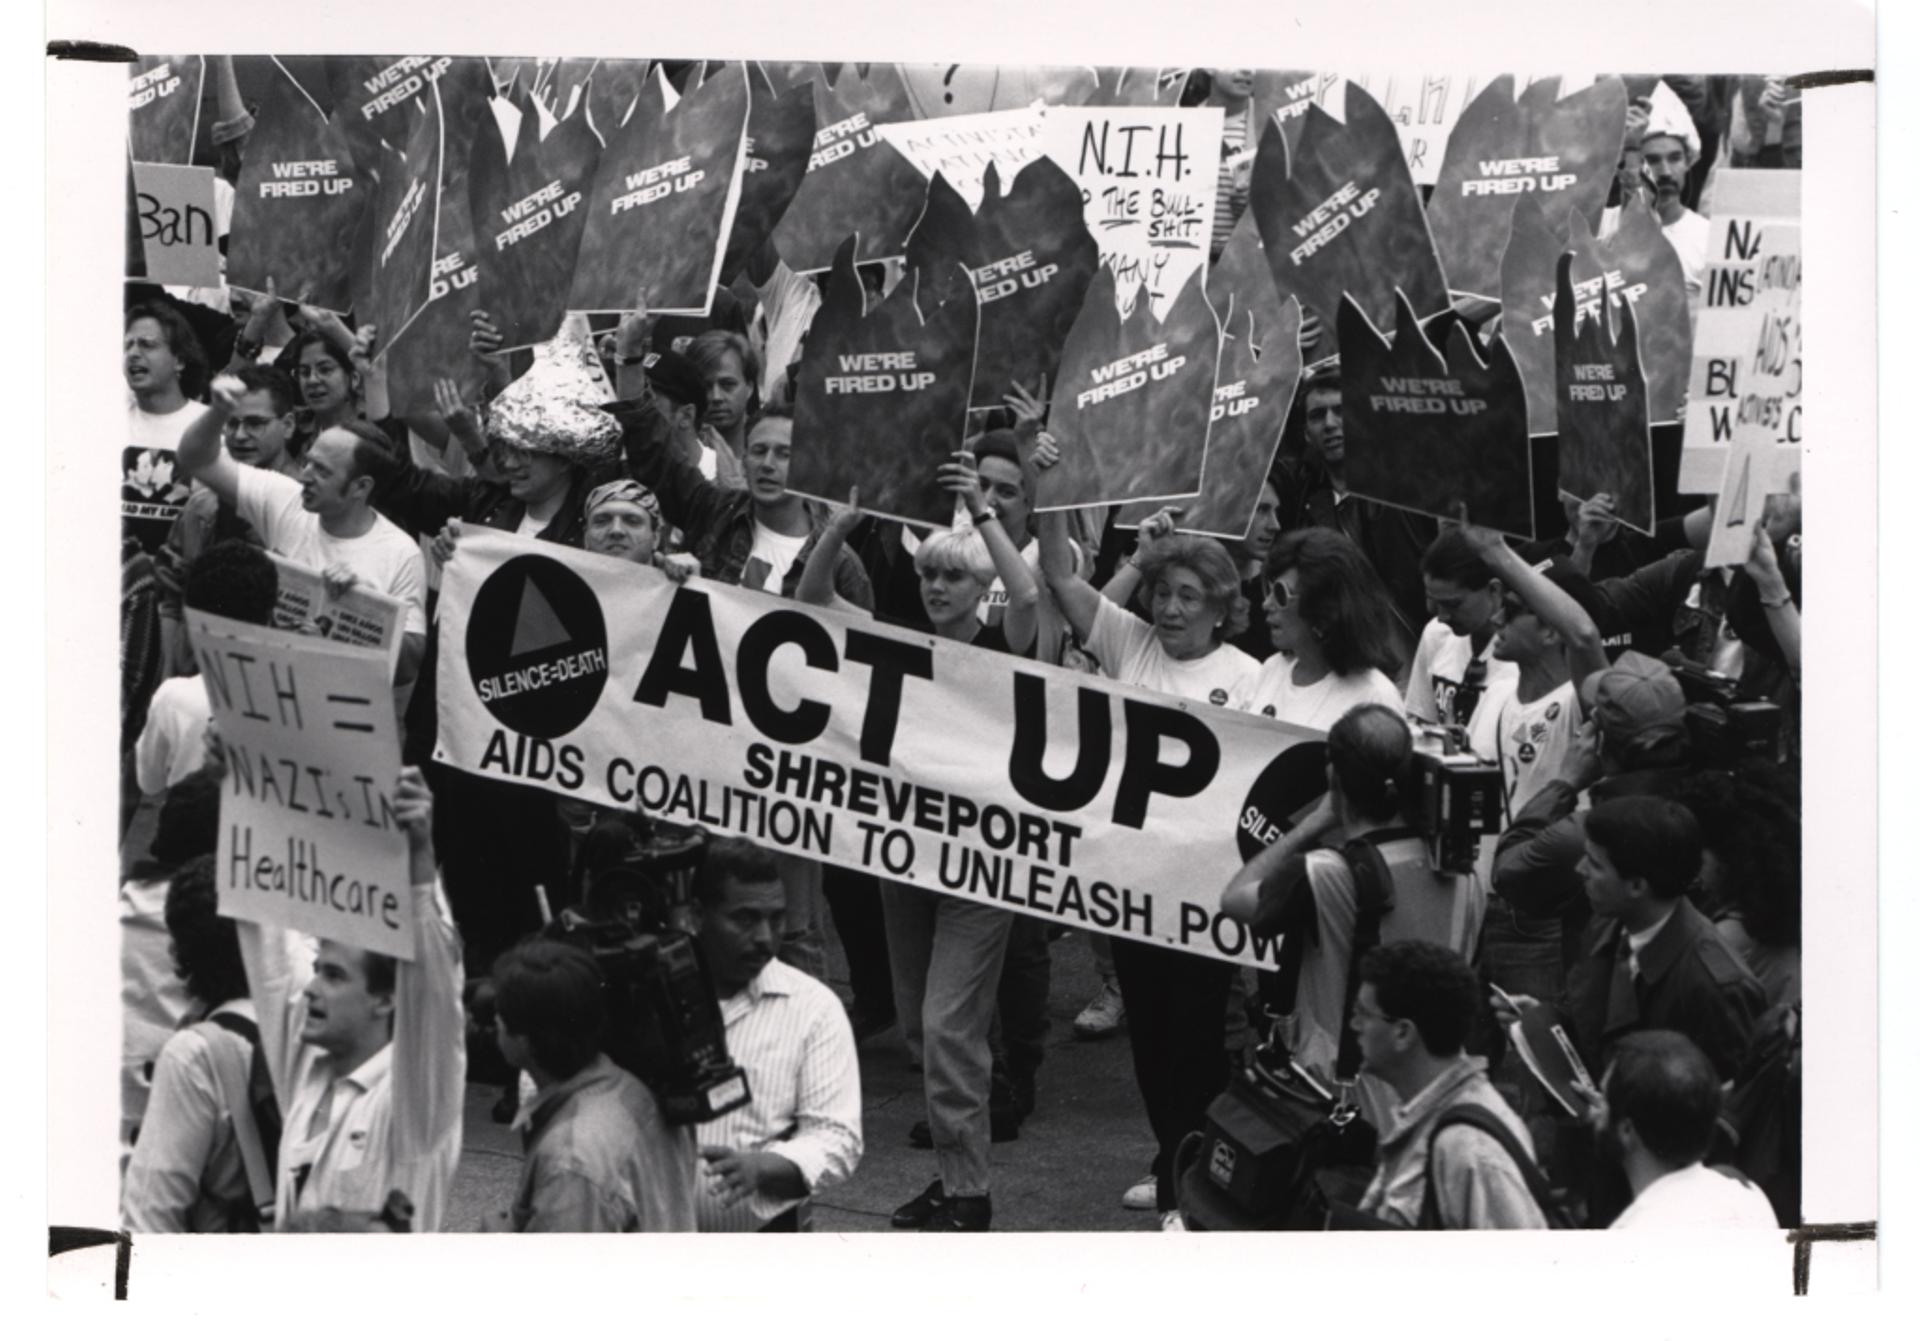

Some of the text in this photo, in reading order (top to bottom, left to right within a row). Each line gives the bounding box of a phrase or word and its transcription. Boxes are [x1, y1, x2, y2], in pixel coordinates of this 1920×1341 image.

[158, 76, 180, 97] UP
[361, 57, 452, 121] FIRED UP
[272, 160, 338, 178] WE'RE
[1079, 120, 1192, 182] N.I.H.
[1479, 156, 1560, 176] WE'RE
[259, 178, 354, 198] FIRED UP
[611, 170, 706, 215] FIRED UP
[624, 156, 691, 190] WE'RE
[1462, 174, 1578, 197] FIRED UP
[495, 191, 583, 251] FIRED UP
[501, 180, 565, 225] WE'RE
[1102, 187, 1141, 219] THE
[1292, 181, 1361, 237] WE'RE
[1290, 188, 1381, 266] FIRED UP
[1021, 263, 1059, 289] UP
[838, 352, 917, 372] WE'RE
[1091, 344, 1169, 383] WE'RE
[824, 373, 937, 395] FIRED UP
[1077, 356, 1187, 410] FIRED UP
[1381, 377, 1465, 396] WE'RE
[1569, 384, 1628, 401] FIRED UP
[1227, 396, 1260, 418] UP
[1371, 395, 1488, 414] FIRED UP
[203, 650, 303, 731] NIH
[479, 648, 607, 703] SILENCE=DEATH
[633, 585, 1221, 830] ACT UP
[744, 742, 1082, 868] SHREVEPORT
[480, 729, 585, 791] AIDS
[606, 757, 833, 856] COALITION
[856, 820, 915, 876] TO
[938, 841, 1153, 938] UNLEASH
[230, 823, 400, 931] Healthcare
